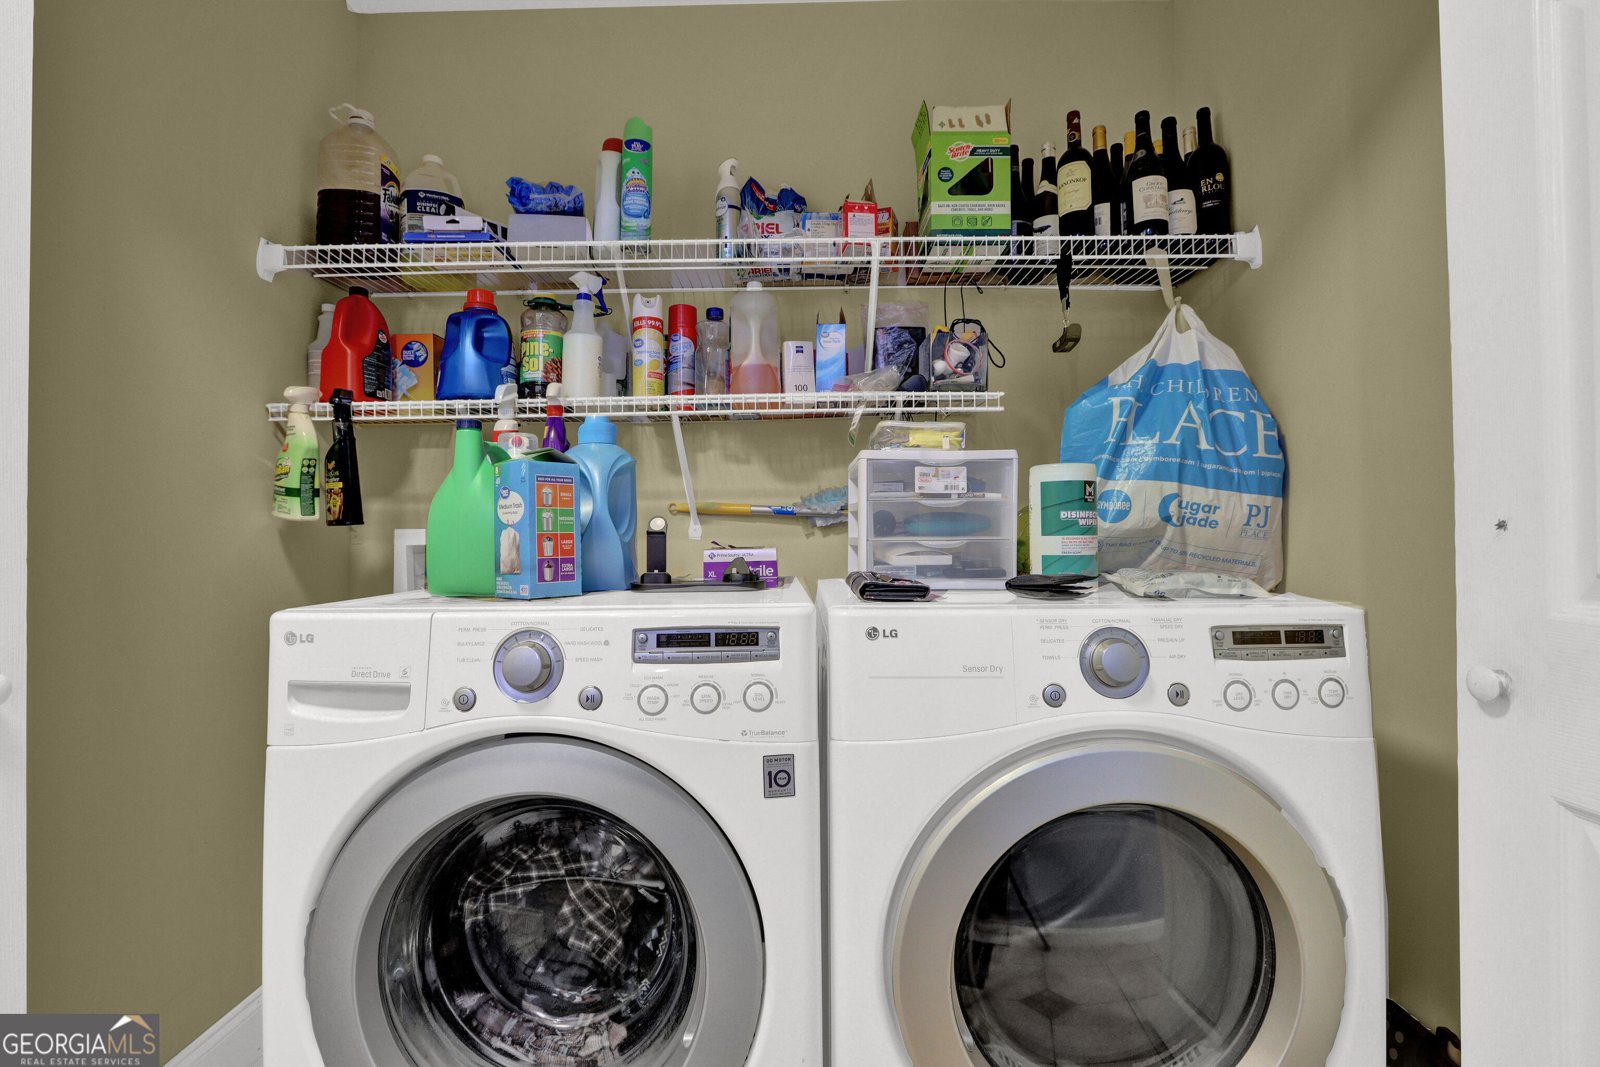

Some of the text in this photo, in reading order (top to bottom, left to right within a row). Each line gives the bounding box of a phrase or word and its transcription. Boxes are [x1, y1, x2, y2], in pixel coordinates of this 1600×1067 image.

[1242, 504, 1271, 528] PJ
[1189, 551, 1220, 563] RECYCLED
[300, 634, 314, 644] LG
[882, 629, 898, 639] LG
[990, 664, 1003, 674] Dry
[768, 770, 791, 788] 10
